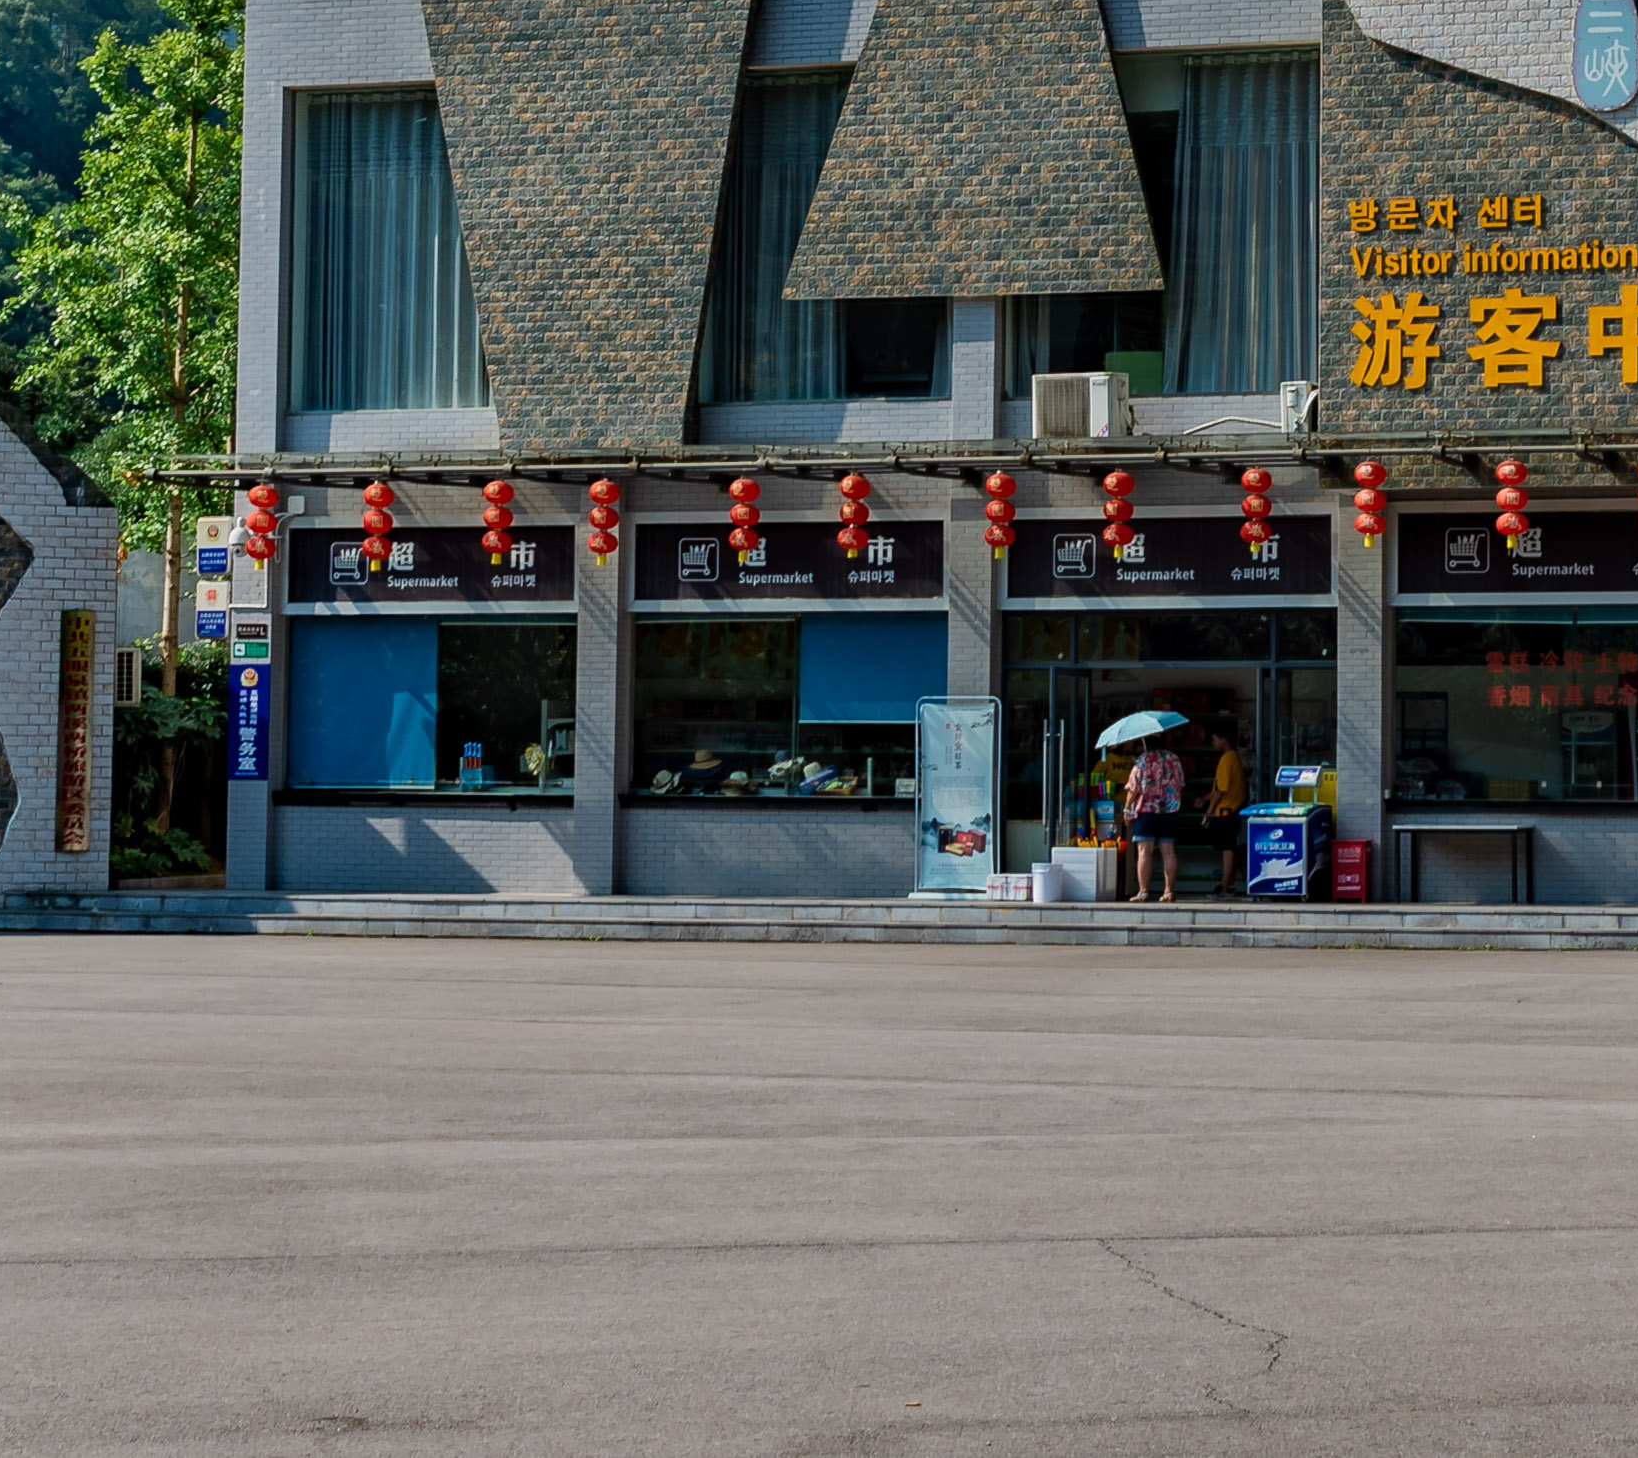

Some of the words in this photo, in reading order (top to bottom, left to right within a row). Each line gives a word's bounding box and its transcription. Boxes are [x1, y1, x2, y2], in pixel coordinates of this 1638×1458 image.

[1349, 197, 1457, 233] 방문자
[1478, 194, 1543, 228] 센터
[1350, 245, 1452, 277] Visitor
[387, 541, 537, 571] 超市
[740, 536, 895, 567] 超市
[739, 571, 814, 588] Supermarket
[1115, 568, 1195, 585] Supermarket
[1512, 562, 1595, 579] Supermarket
[387, 574, 459, 592] Supermarket
[1488, 685, 1530, 707] 香烟
[1540, 685, 1583, 707] 雨具
